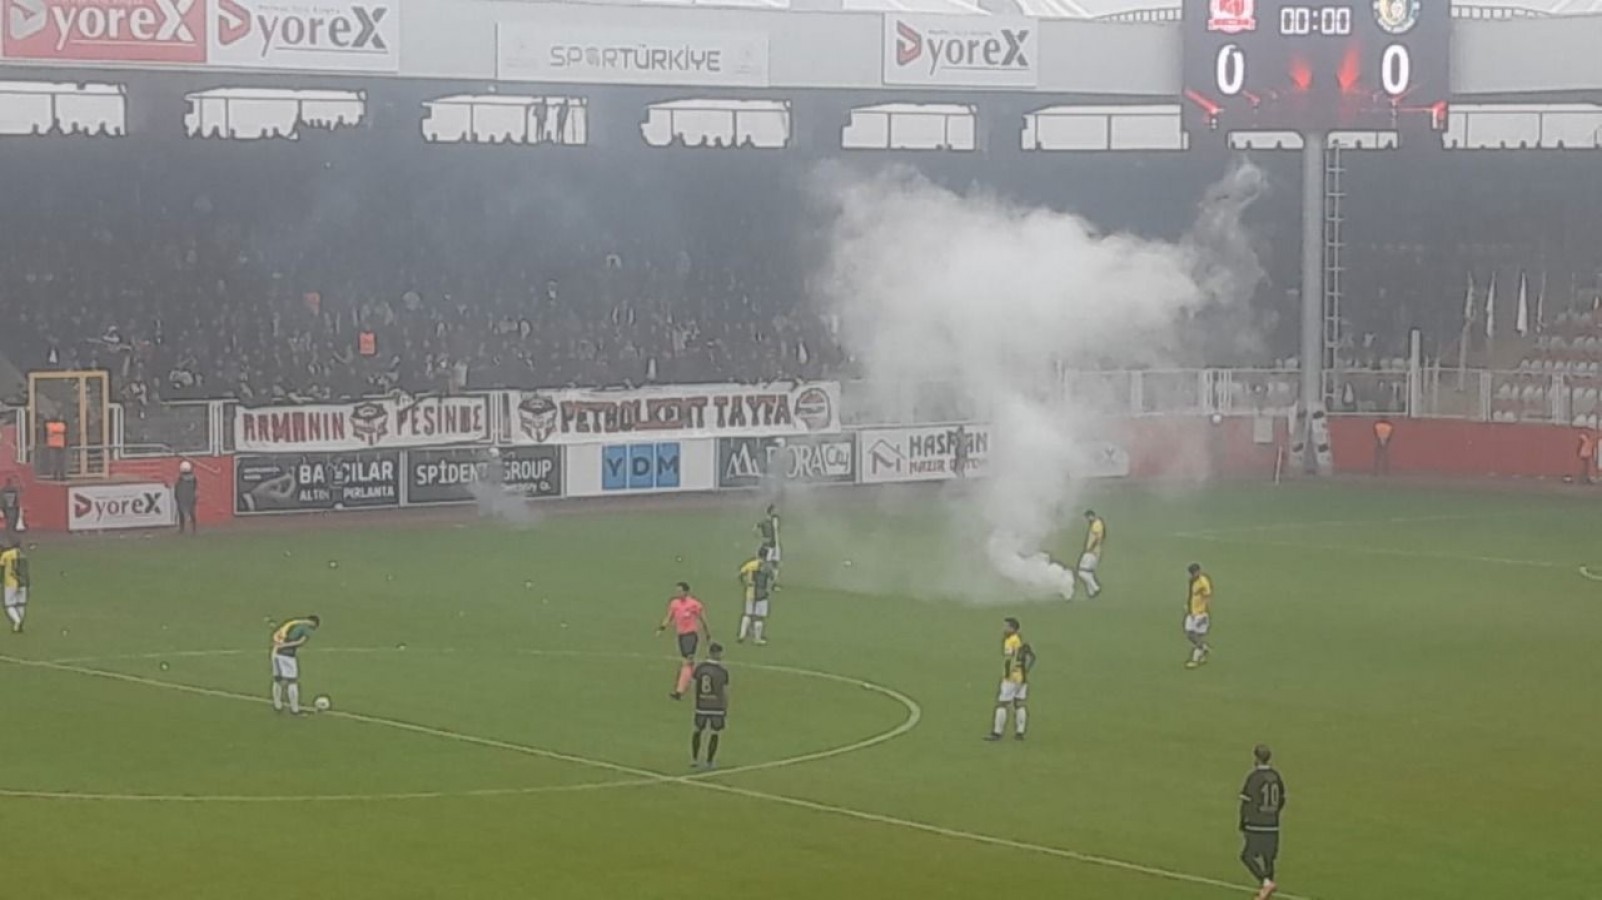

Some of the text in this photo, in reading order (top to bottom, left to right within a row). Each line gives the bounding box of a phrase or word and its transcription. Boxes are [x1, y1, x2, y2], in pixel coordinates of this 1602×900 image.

[1280, 8, 1351, 35] 00:00
[1217, 45, 1244, 94] 0
[1382, 45, 1410, 94] 0
[713, 394, 791, 427] TAYFA
[607, 456, 679, 477] YDM
[701, 674, 712, 694] 8
[1260, 782, 1280, 808] 10
